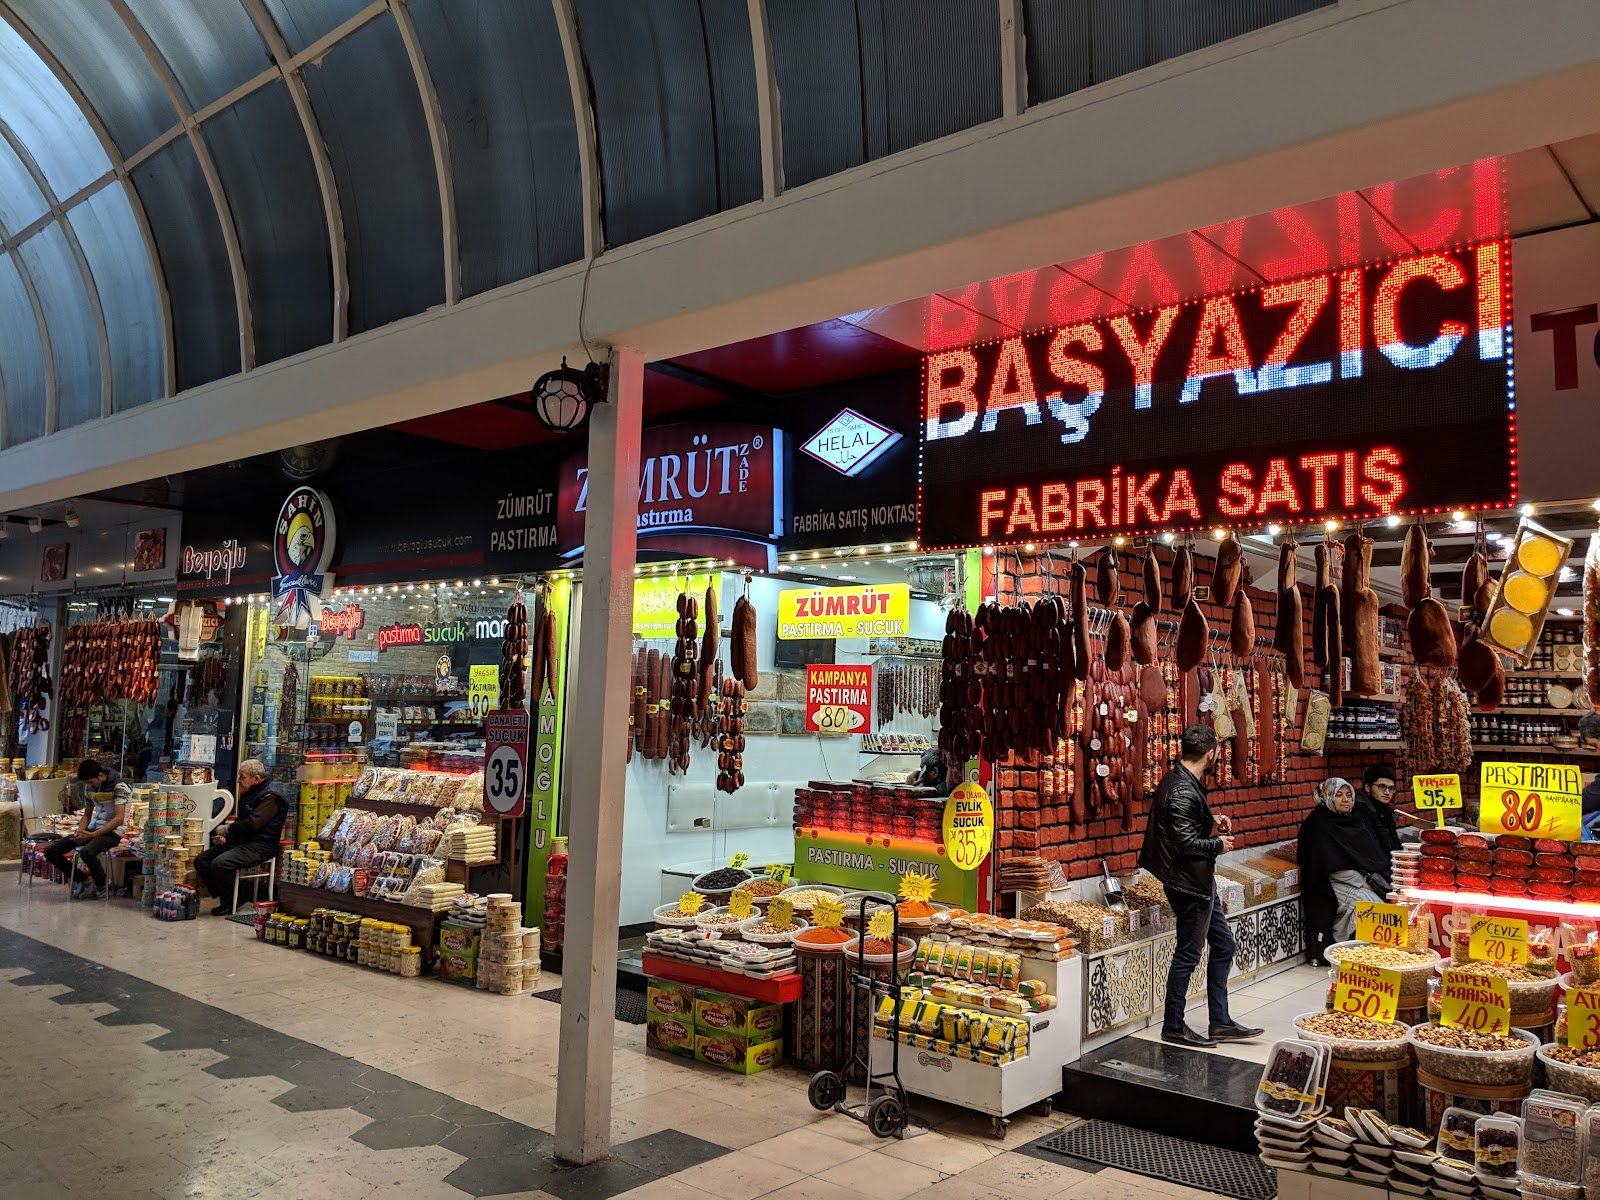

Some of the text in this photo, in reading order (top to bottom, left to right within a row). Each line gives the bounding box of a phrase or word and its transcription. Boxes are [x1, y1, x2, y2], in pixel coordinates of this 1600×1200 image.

[926, 242, 1504, 444] BAŞYAZICI
[1530, 303, 1600, 390] T
[818, 431, 875, 453] HELAL
[575, 434, 739, 512] ZMRÜT
[739, 443, 749, 493] ZADE
[497, 489, 553, 520] ZÜMRÜT
[980, 447, 1402, 537] FABRİKA SATIŞ
[793, 508, 836, 533] FABRİKA
[838, 506, 867, 531] SATIŞ
[491, 525, 557, 551] PASTIRMA
[183, 539, 246, 585] Beyoğlu
[795, 588, 890, 617] ZÜMRÜT
[424, 620, 465, 643] sucuk
[475, 619, 509, 639] man
[782, 619, 844, 637] PASTIRMA
[856, 619, 905, 636] SUCUK
[810, 670, 868, 686] KAMPANYA
[472, 693, 490, 716] 80
[809, 687, 868, 705] PASTIRMA
[489, 714, 526, 726] DANA ETİ
[821, 706, 846, 728] 80
[488, 729, 525, 743] SUCUK
[490, 758, 519, 797] 35
[1485, 765, 1579, 794] PASTIRMA
[956, 800, 982, 812] EVLİK
[1423, 789, 1446, 807] 95
[1501, 790, 1543, 832] 80
[953, 817, 984, 828] SUCUK
[956, 830, 977, 866] 35
[808, 847, 875, 871] PASTIRMA
[888, 858, 940, 880] SUCUK
[1373, 925, 1392, 943] 60
[1484, 940, 1505, 960] 70
[1342, 988, 1381, 1018] 50
[1445, 985, 1505, 1009] KARIŞIK
[1574, 991, 1600, 1010] AT
[1453, 1003, 1488, 1030] 40
[1582, 1013, 1600, 1047] 3
